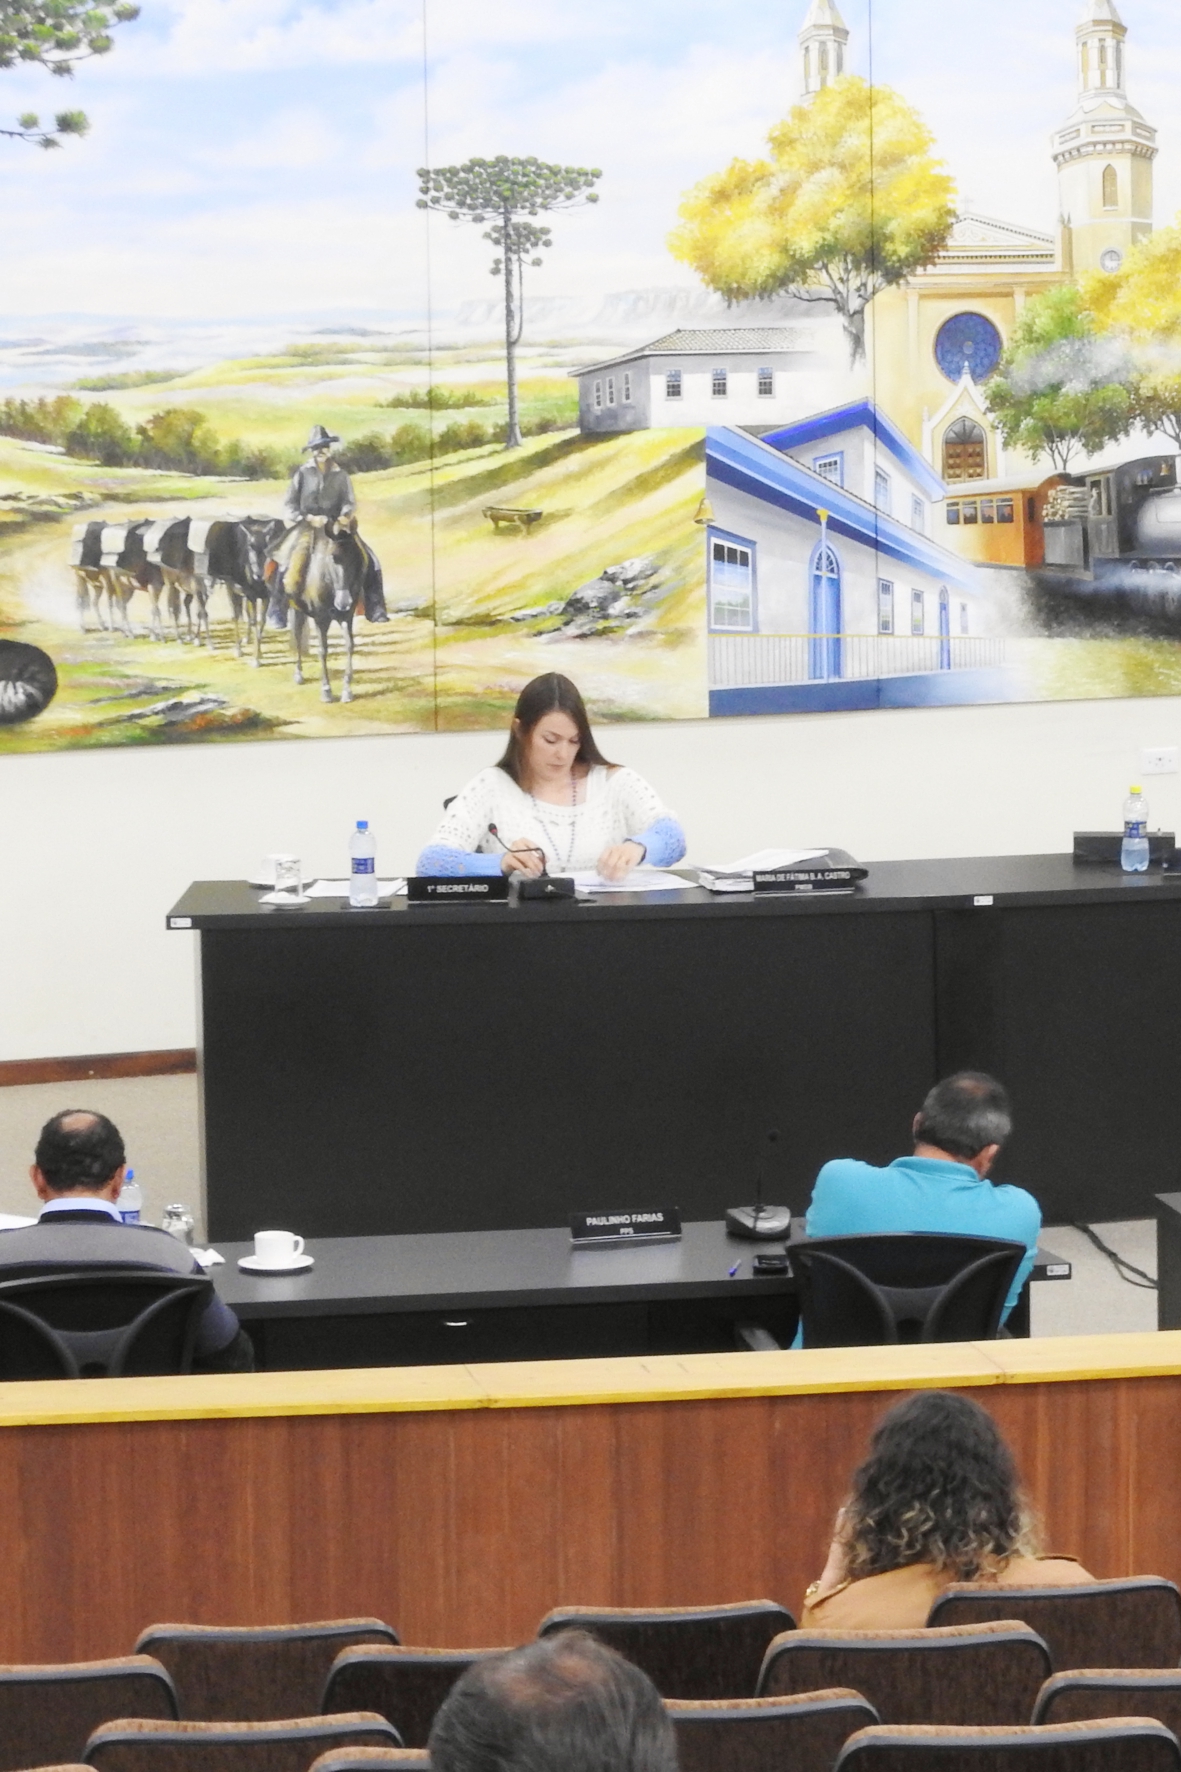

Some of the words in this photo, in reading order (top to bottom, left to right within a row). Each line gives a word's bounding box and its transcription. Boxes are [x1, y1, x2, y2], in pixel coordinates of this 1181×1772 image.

[755, 873, 776, 882] MARIA
[776, 873, 785, 881] DE
[824, 871, 851, 880] CASTRO
[436, 883, 489, 893] SECRETÁRIO
[586, 1214, 631, 1226] PAULINHO
[631, 1212, 664, 1223] FARIAS
